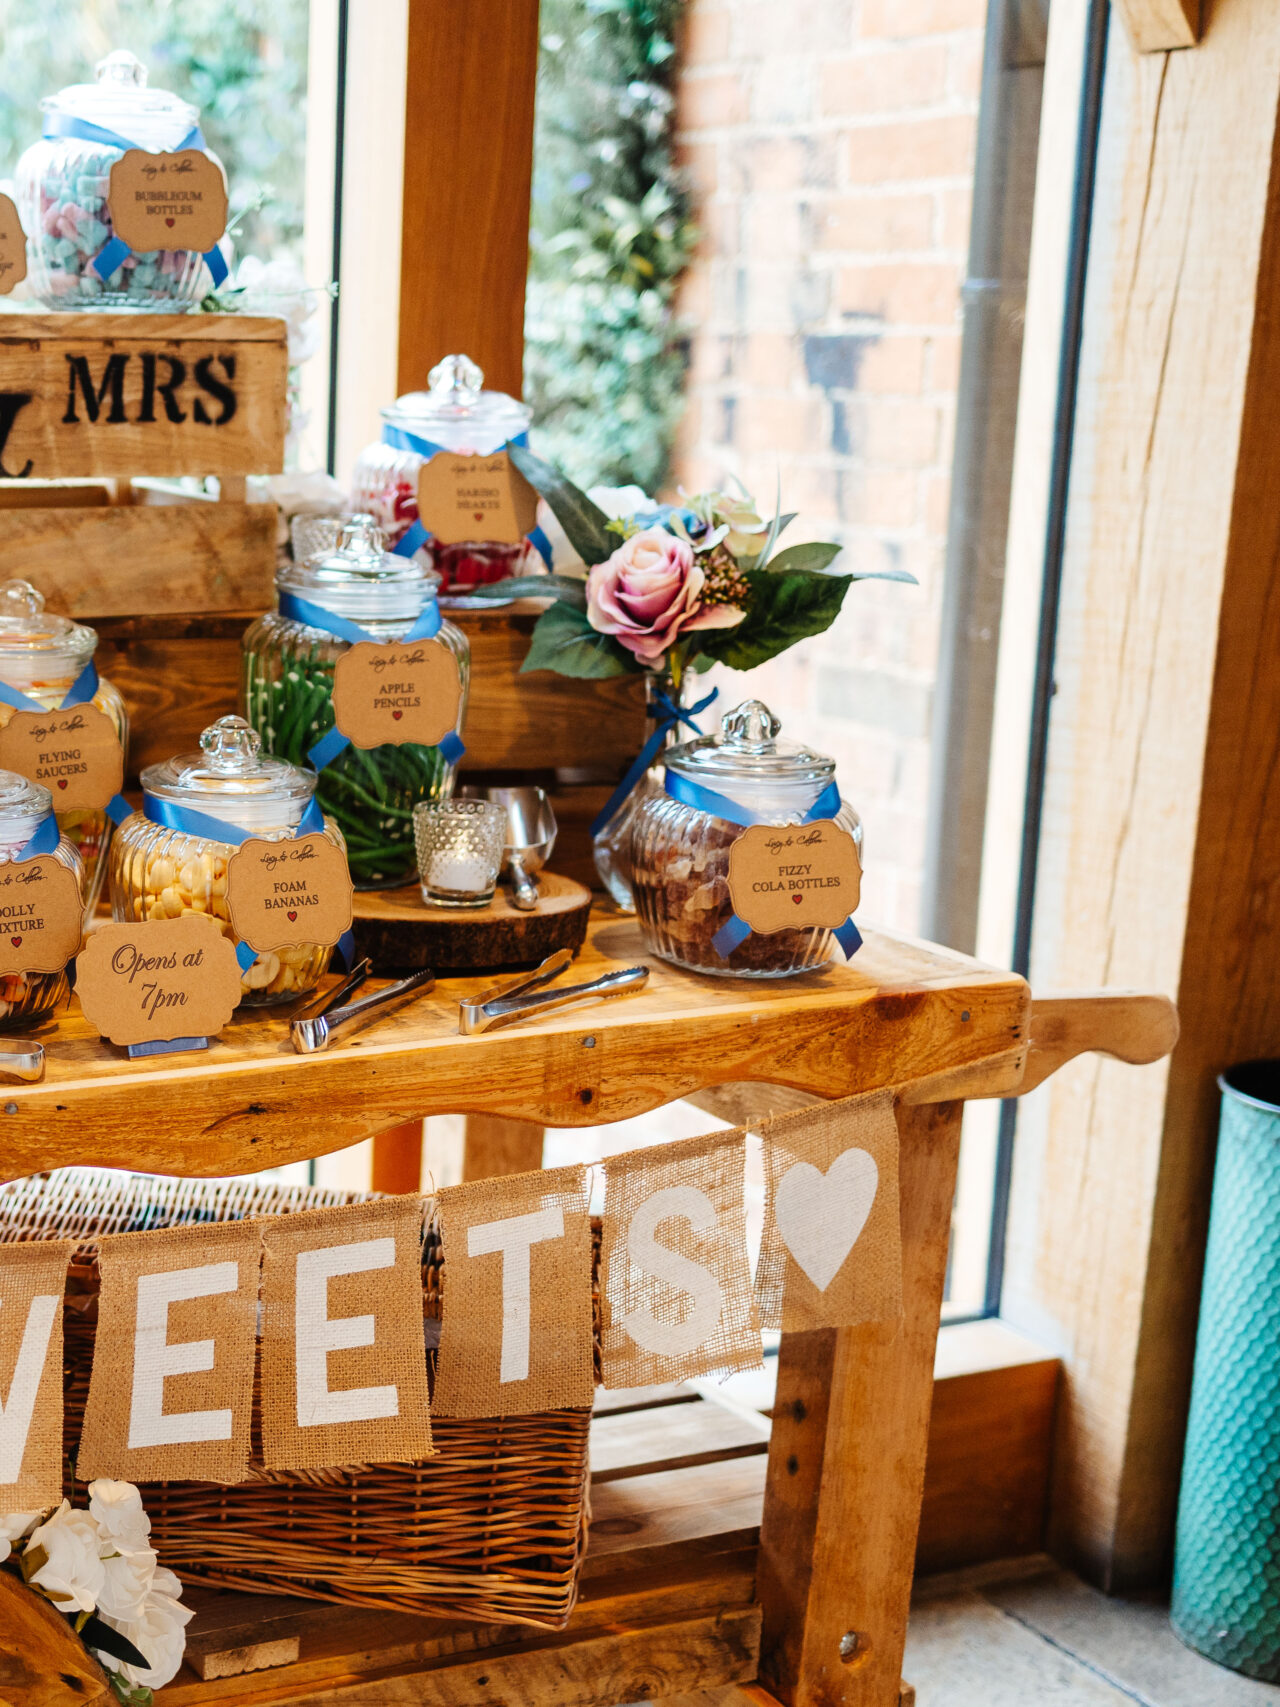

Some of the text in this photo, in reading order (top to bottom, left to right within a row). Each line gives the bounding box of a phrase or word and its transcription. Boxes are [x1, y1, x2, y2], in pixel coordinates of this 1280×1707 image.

[135, 191, 202, 201] BUBBLEGUM
[146, 205, 194, 215] BOTTLES
[62, 353, 237, 426] MRS
[379, 683, 415, 694] APPLE
[373, 697, 421, 708] PENCILS
[39, 749, 81, 764] FLYING
[36, 762, 88, 779] SAUCERS
[778, 864, 812, 876] FIZZY
[273, 881, 307, 893] FOAM
[752, 876, 841, 893] COLA BOTTLES
[264, 895, 319, 909] BANANAS
[111, 943, 204, 983] Opens at
[141, 982, 188, 1020] 7pm
